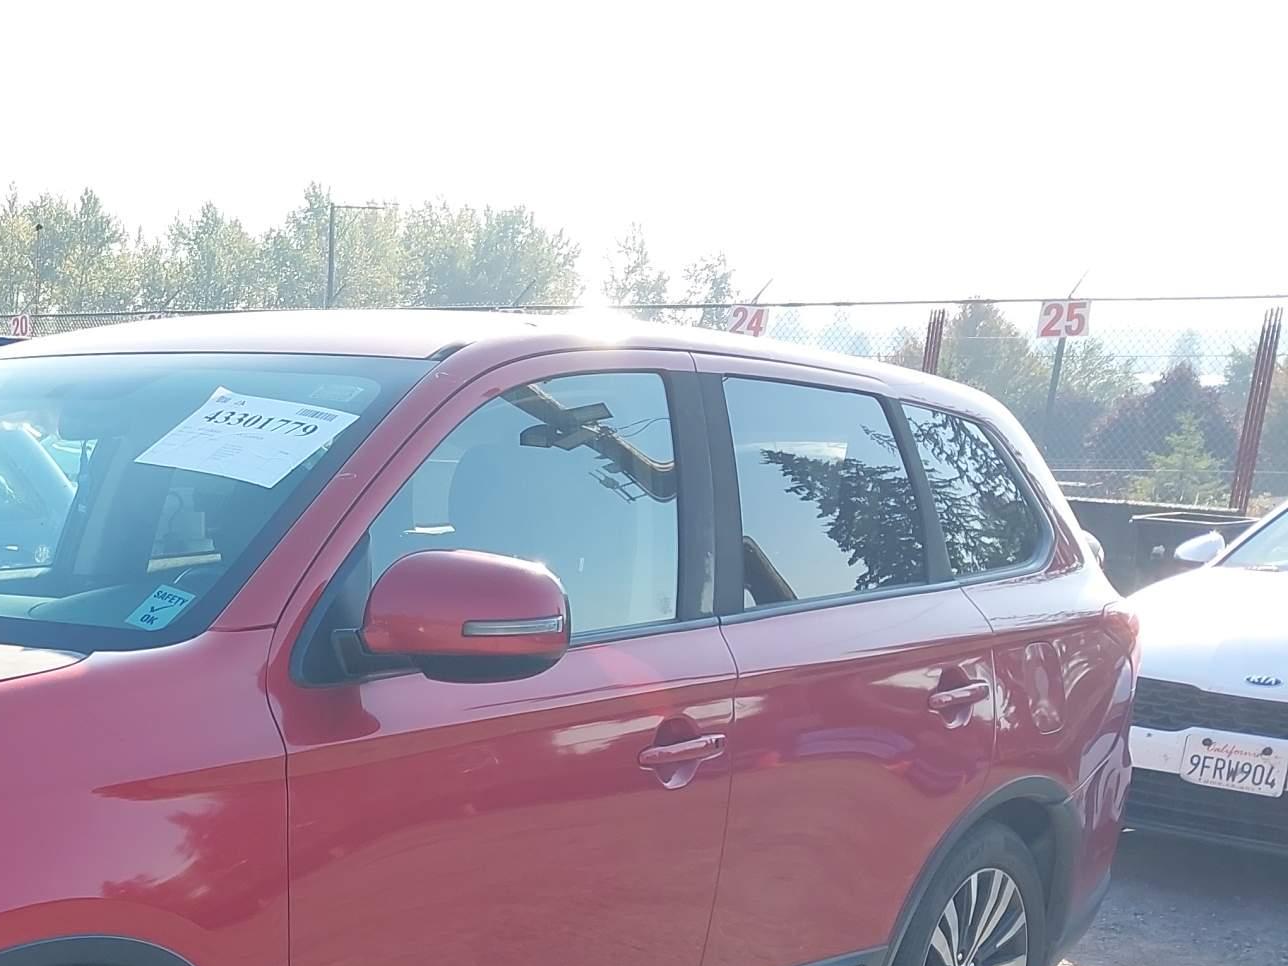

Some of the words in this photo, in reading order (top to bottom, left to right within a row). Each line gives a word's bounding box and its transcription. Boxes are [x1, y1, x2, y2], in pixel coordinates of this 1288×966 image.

[12, 315, 29, 336] 20
[729, 307, 764, 337] 24
[1040, 302, 1086, 337] 25
[204, 409, 319, 437] 43301779
[154, 590, 189, 606] SAFETY
[140, 614, 158, 625] OK
[1244, 675, 1280, 686] KIA
[1187, 754, 1276, 789] 9FRW904
